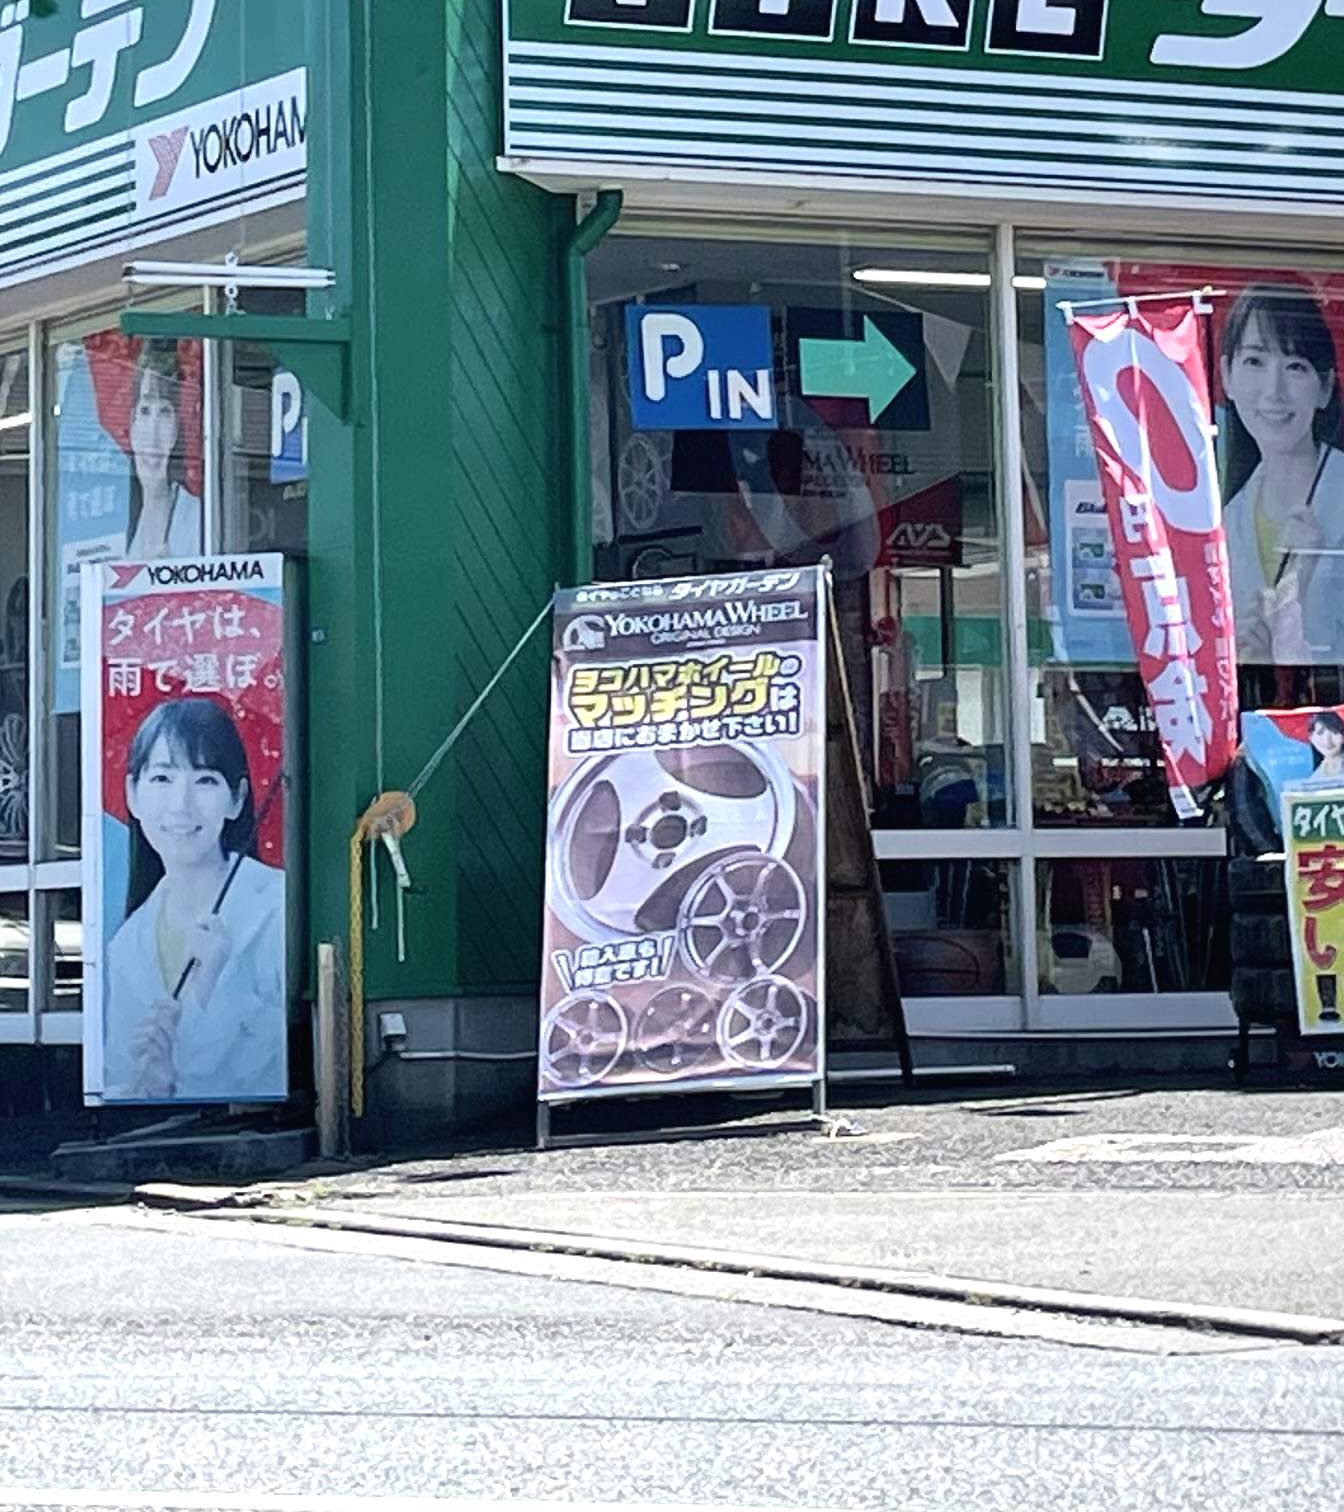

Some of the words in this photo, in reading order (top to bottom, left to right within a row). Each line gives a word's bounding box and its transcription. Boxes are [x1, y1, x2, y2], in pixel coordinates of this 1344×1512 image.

[191, 96, 305, 178] YOKOHAM
[640, 313, 705, 402] P
[706, 369, 773, 420] IN
[271, 371, 301, 457] P
[148, 560, 263, 586] YOKOHAMA
[668, 573, 800, 600] タイヤガーデン
[108, 604, 261, 646] タイヤは、
[605, 609, 728, 636] YOKOHAMA
[725, 599, 808, 625] WHEEL
[574, 652, 802, 692] ヨコハマホイールの
[571, 677, 798, 727] マッチングは
